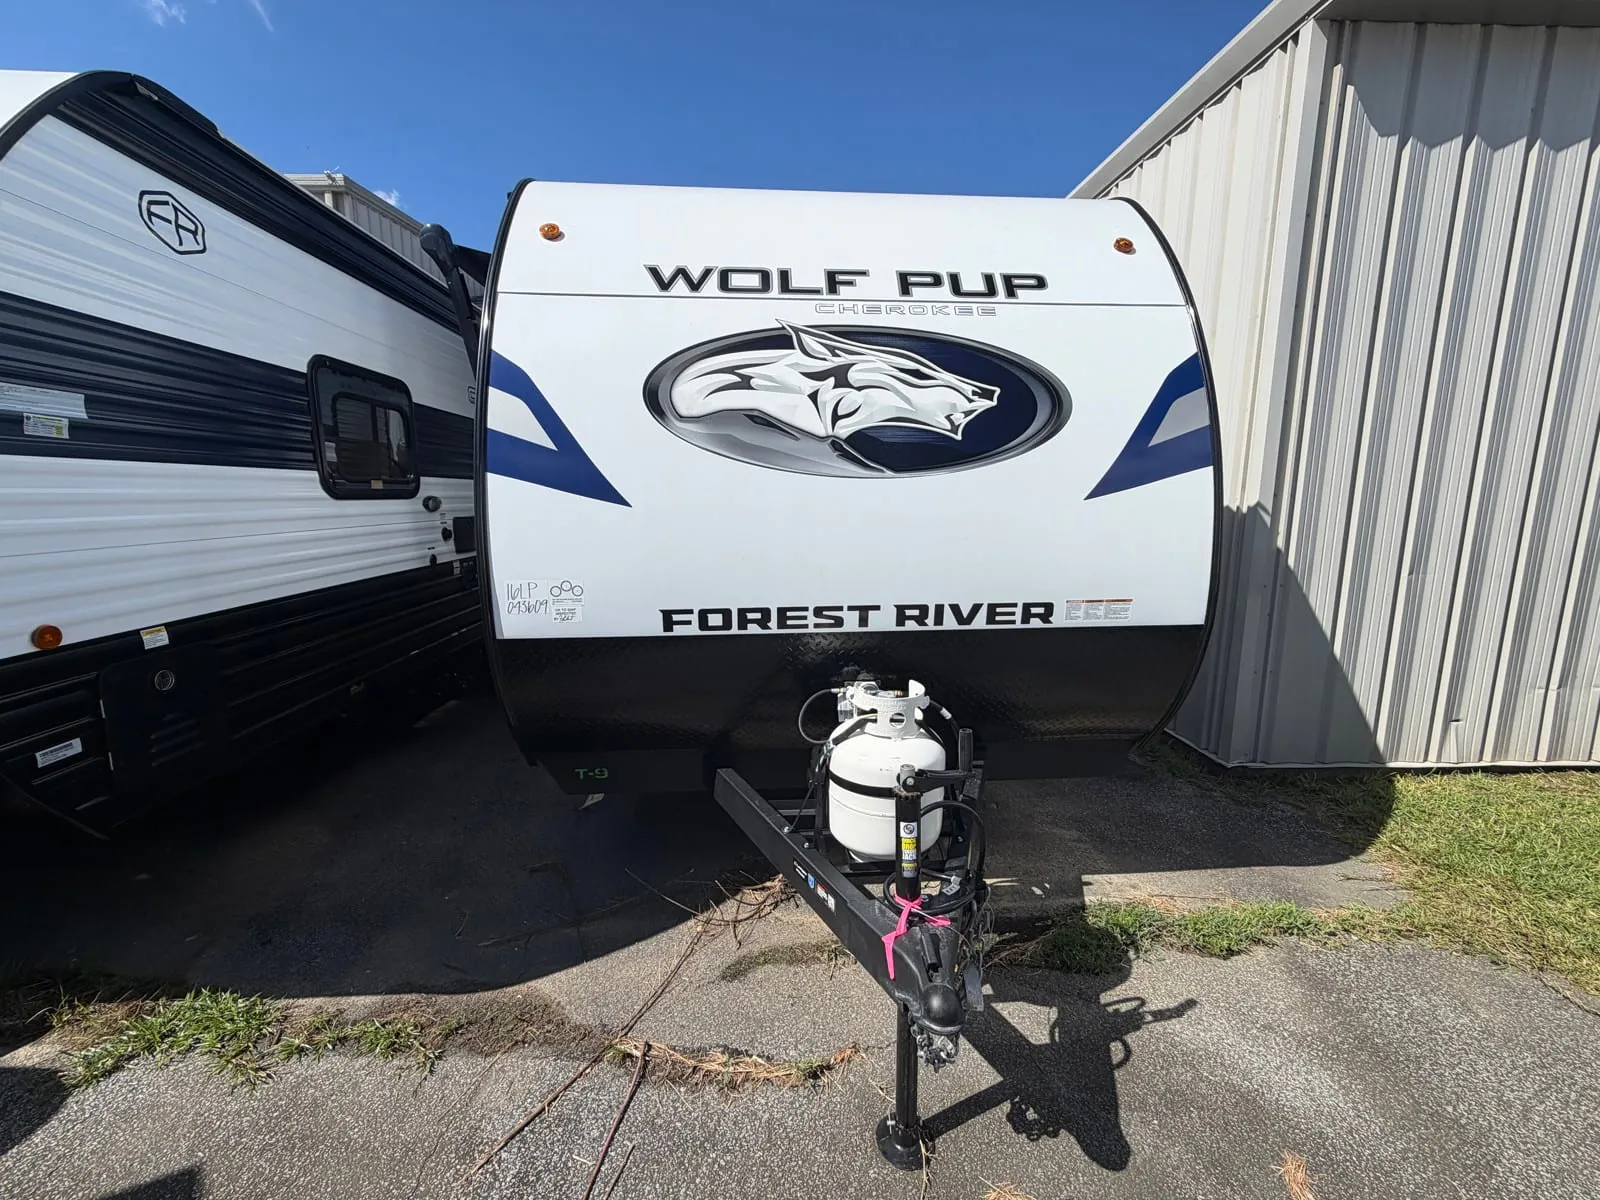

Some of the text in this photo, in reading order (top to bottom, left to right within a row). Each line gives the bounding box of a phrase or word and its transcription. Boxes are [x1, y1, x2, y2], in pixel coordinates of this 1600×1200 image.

[643, 264, 1049, 299] WOLF PUP
[814, 302, 998, 317] CHEROKEE
[659, 605, 881, 632] FOREST
[893, 601, 1055, 628] RIVER
[574, 767, 609, 780] T-9
